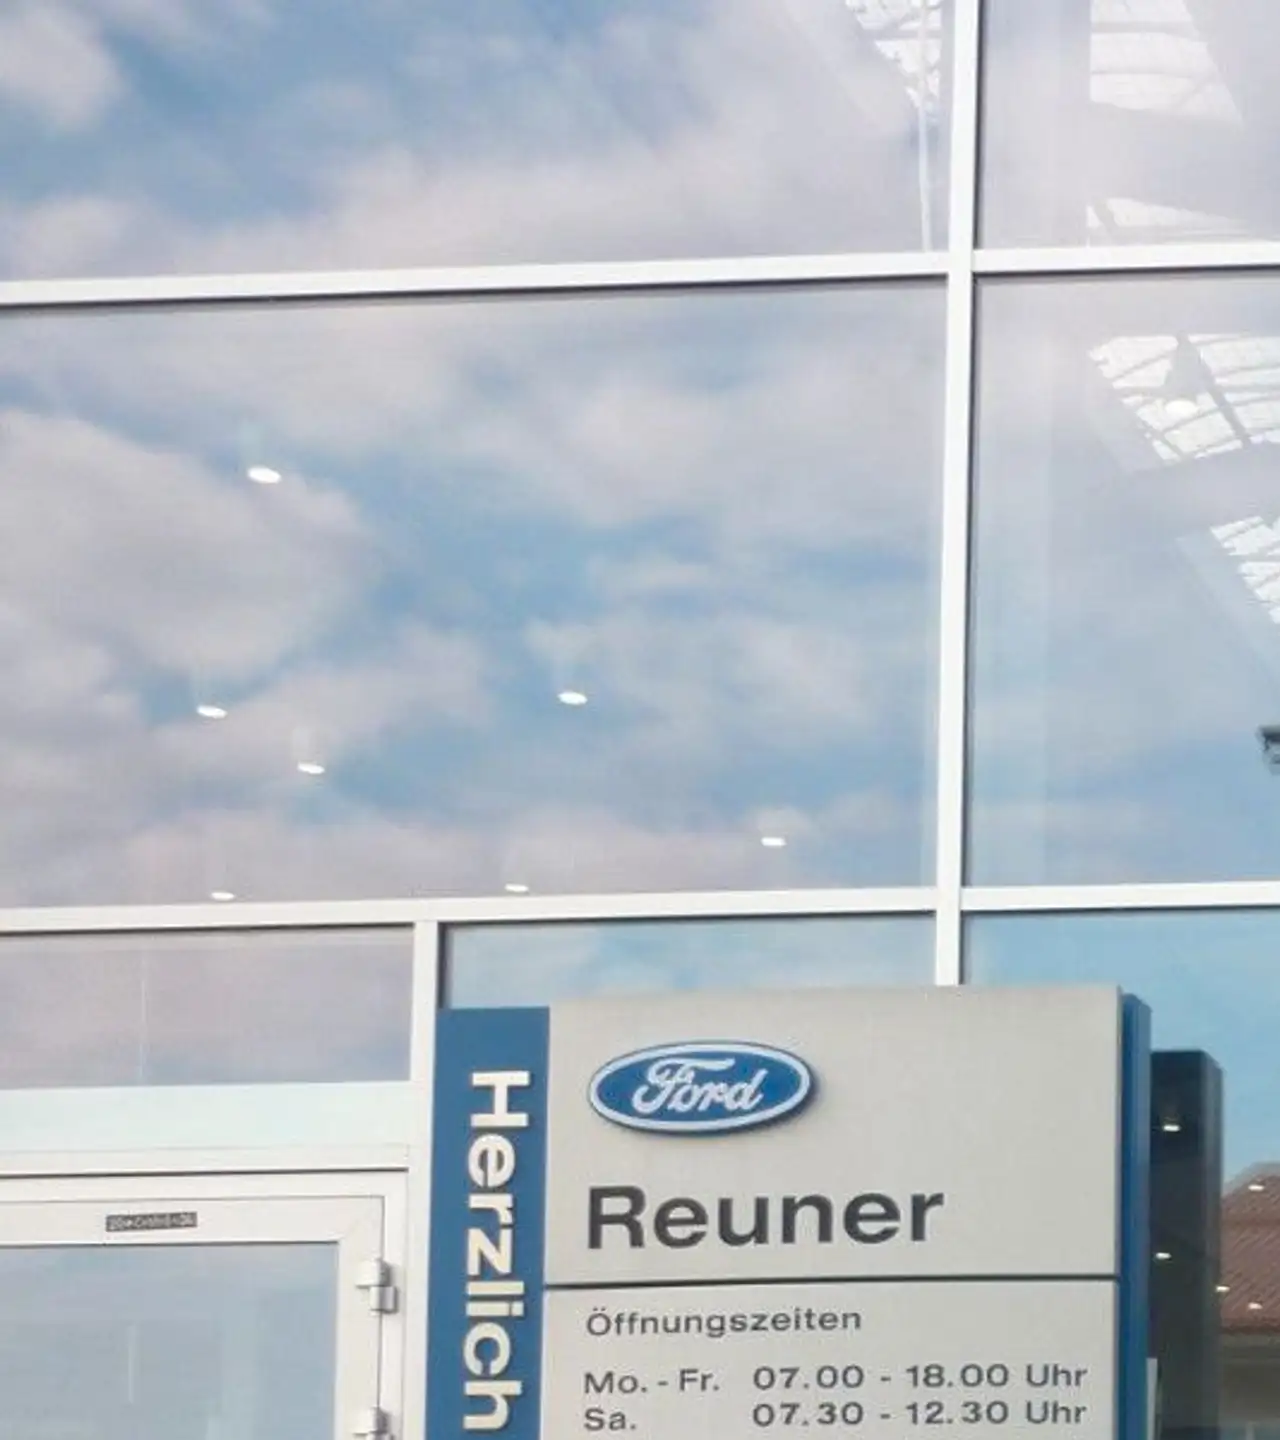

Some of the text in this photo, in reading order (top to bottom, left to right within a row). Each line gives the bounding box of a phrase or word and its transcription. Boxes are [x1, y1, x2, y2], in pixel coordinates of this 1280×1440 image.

[631, 1056, 769, 1114] Ford
[588, 1184, 945, 1250] Reuner
[462, 1070, 531, 1430] Herzlich
[586, 1306, 862, 1339] Öffnungszeiten
[583, 1370, 648, 1394] Mo.
[679, 1368, 720, 1391] Fr.
[753, 1364, 865, 1390] 07.00
[905, 1363, 1009, 1388] 18.00
[1026, 1363, 1088, 1387] Uhr
[583, 1407, 637, 1431] Sa.
[752, 1401, 865, 1427] 07.30
[905, 1400, 1009, 1424] 12.30
[1026, 1400, 1087, 1424] Uhr
